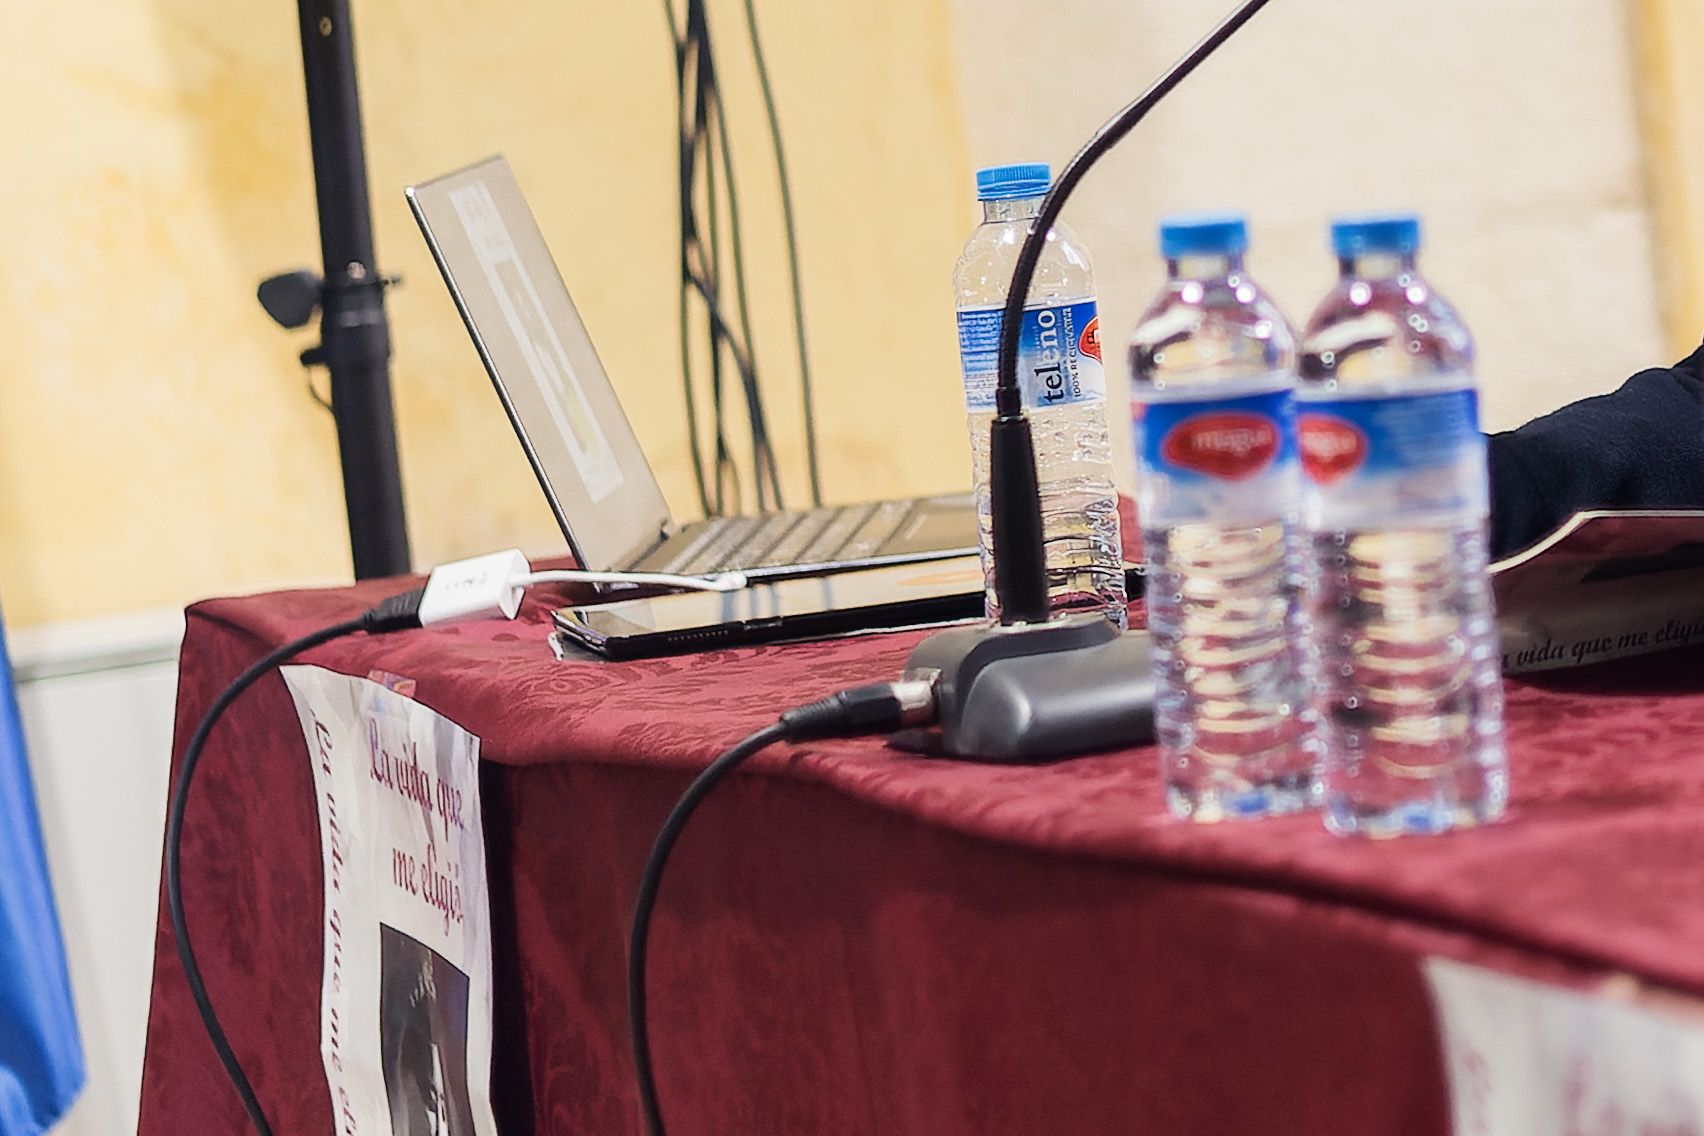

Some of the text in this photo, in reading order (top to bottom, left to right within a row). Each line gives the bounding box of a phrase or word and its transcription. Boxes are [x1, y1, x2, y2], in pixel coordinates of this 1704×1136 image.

[1034, 310, 1065, 403] teleno
[1069, 372, 1082, 398] 100%
[1517, 638, 1565, 666] vida
[1571, 637, 1613, 663] que
[1618, 631, 1649, 649] me
[370, 718, 465, 842] La vida que
[326, 792, 343, 893] vida
[392, 847, 417, 896] me
[329, 908, 343, 993] que
